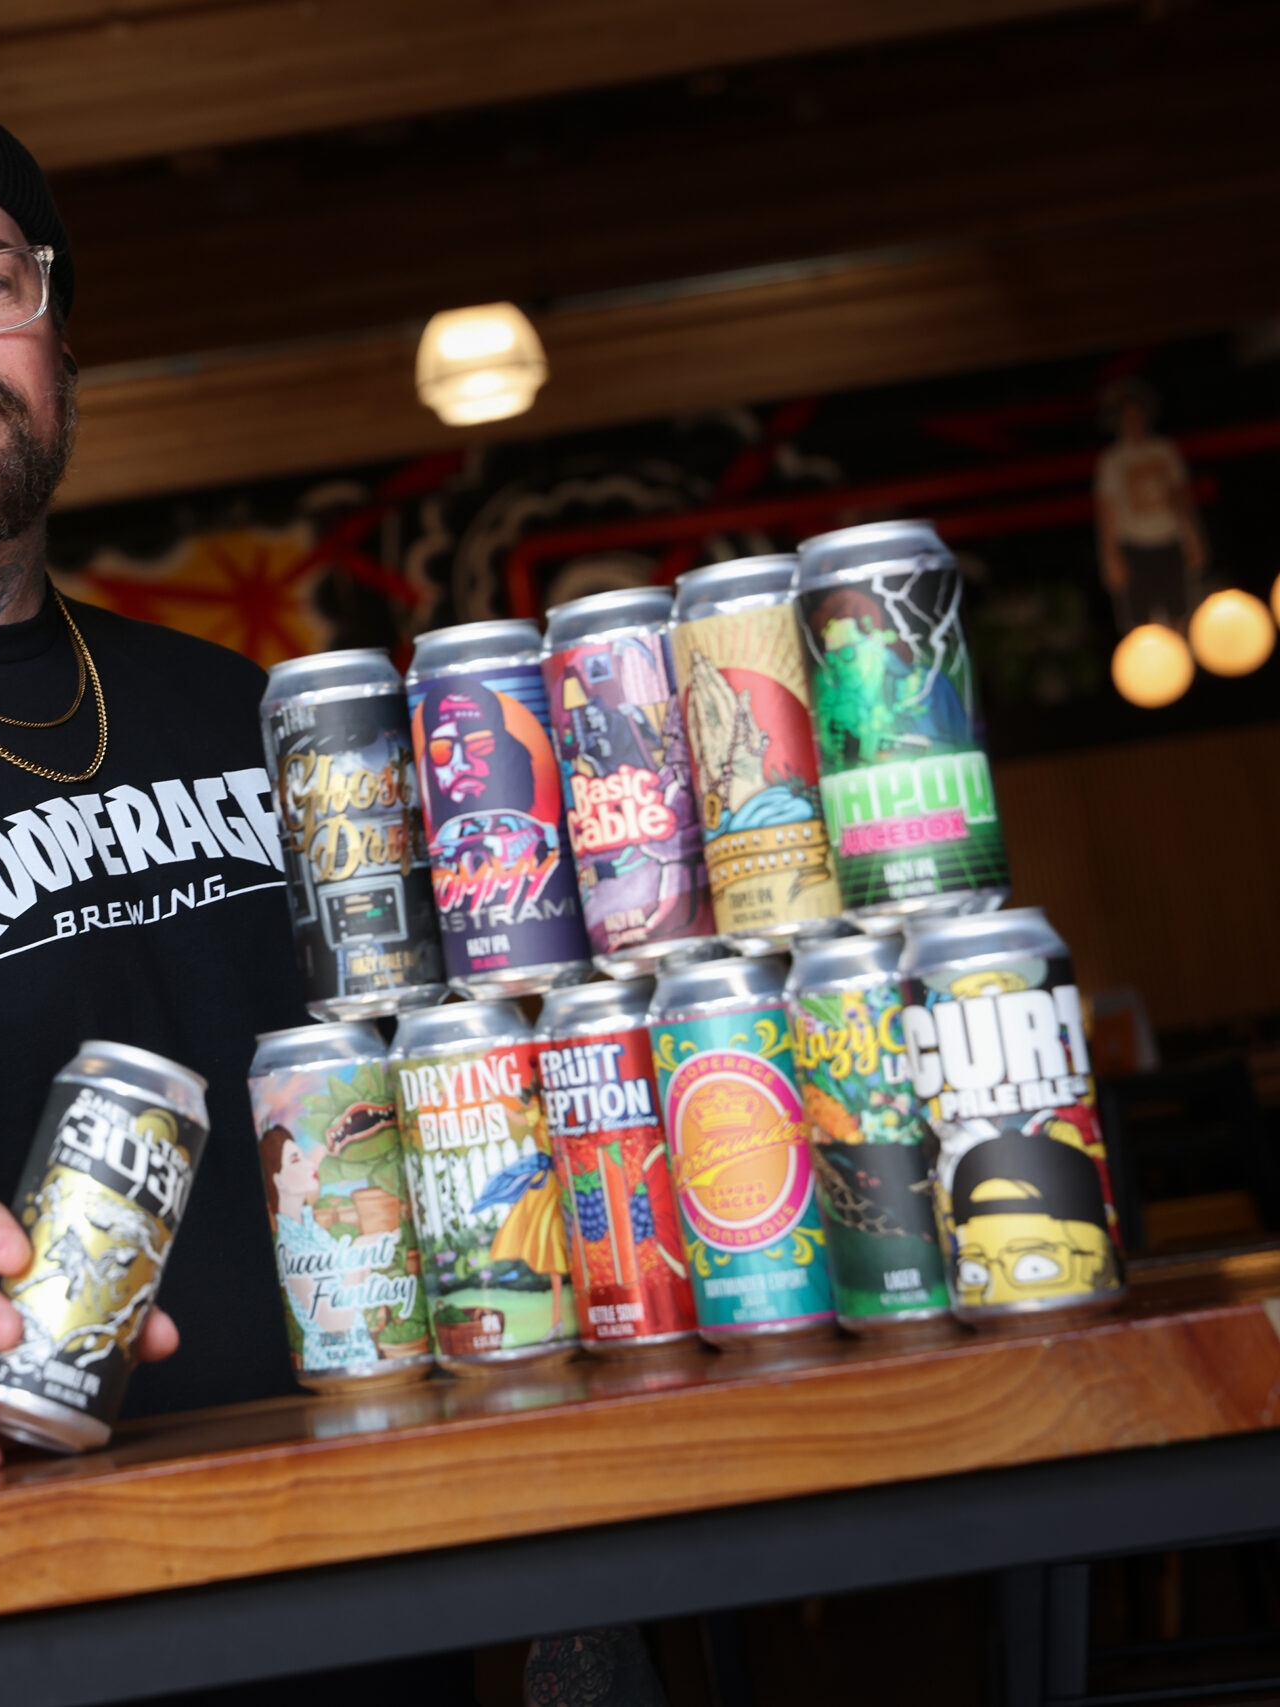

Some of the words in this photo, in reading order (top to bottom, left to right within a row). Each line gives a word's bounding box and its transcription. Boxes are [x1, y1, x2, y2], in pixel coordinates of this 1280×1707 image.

[277, 748, 414, 842] Ghost
[571, 768, 656, 812] Basic
[568, 800, 672, 853] Cable
[840, 810, 968, 855] JUICEBOX
[53, 873, 226, 939] BREWING
[433, 850, 559, 914] OMMY
[539, 1042, 625, 1090] FRUIT
[796, 1012, 880, 1079] Lazy
[400, 1052, 522, 1112] DRYING
[939, 1083, 1020, 1121] PALE
[420, 1104, 510, 1151] BUDS
[277, 1234, 395, 1282] Succulent
[309, 1274, 417, 1321] Fantasy
